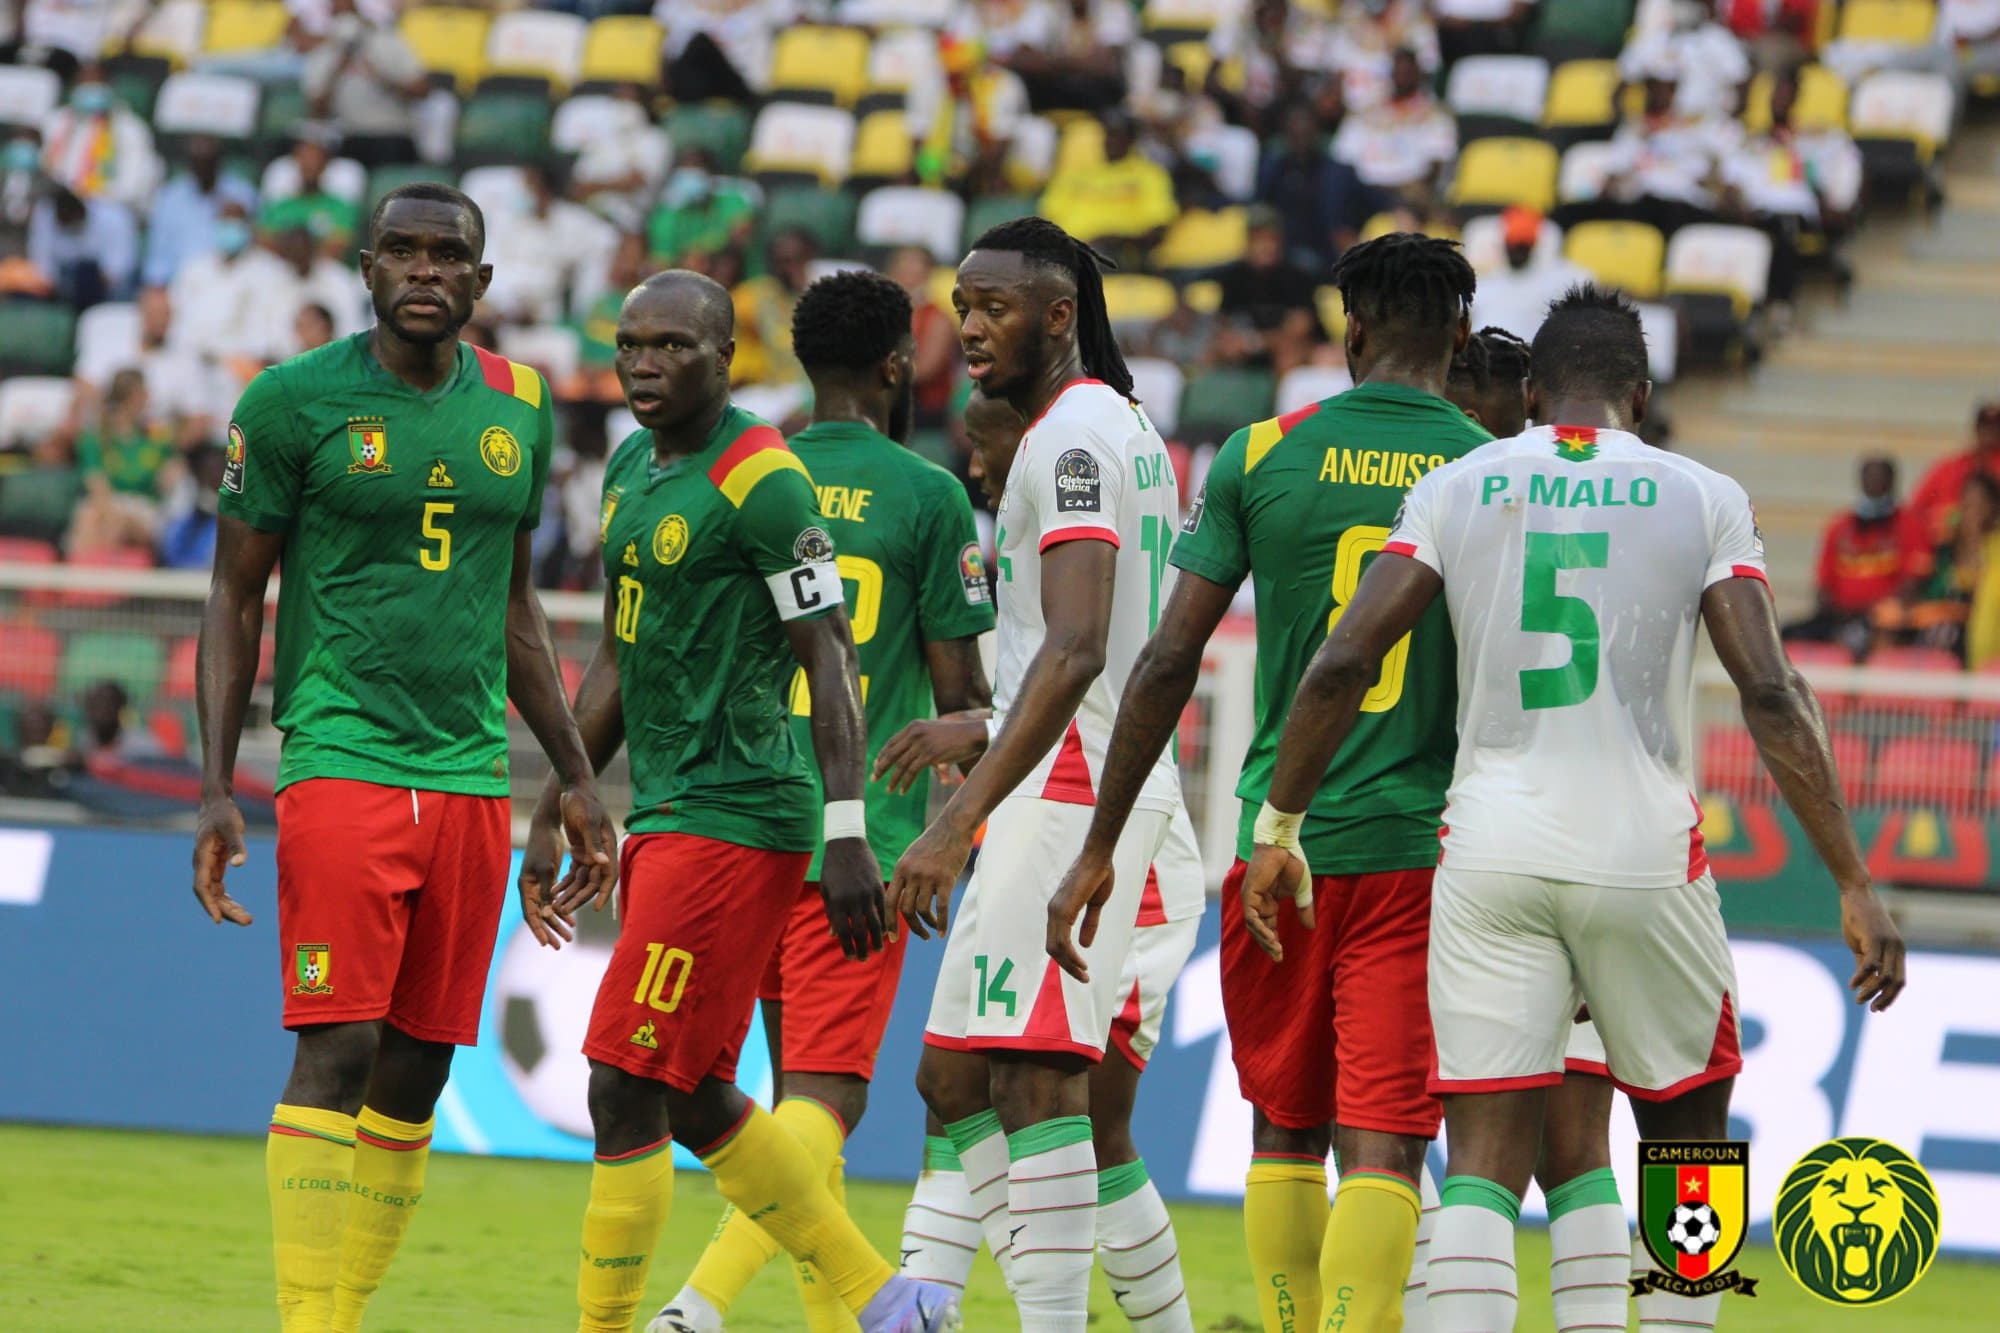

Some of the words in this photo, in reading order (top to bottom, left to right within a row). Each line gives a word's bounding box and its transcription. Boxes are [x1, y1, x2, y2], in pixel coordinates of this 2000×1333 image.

[1058, 474, 1100, 488] Celebrate
[1064, 484, 1091, 493] Africa
[1319, 447, 1460, 489] ANGUISS
[1065, 499, 1093, 507] CAF
[1482, 475, 1512, 506] P.
[1528, 473, 1658, 508] MALO
[419, 502, 455, 572] 5
[790, 567, 821, 610] C
[615, 576, 644, 645] 10
[1518, 531, 1610, 711] 5
[633, 942, 695, 1014] 10
[974, 955, 1017, 1017] 14
[354, 1183, 371, 1198] LE
